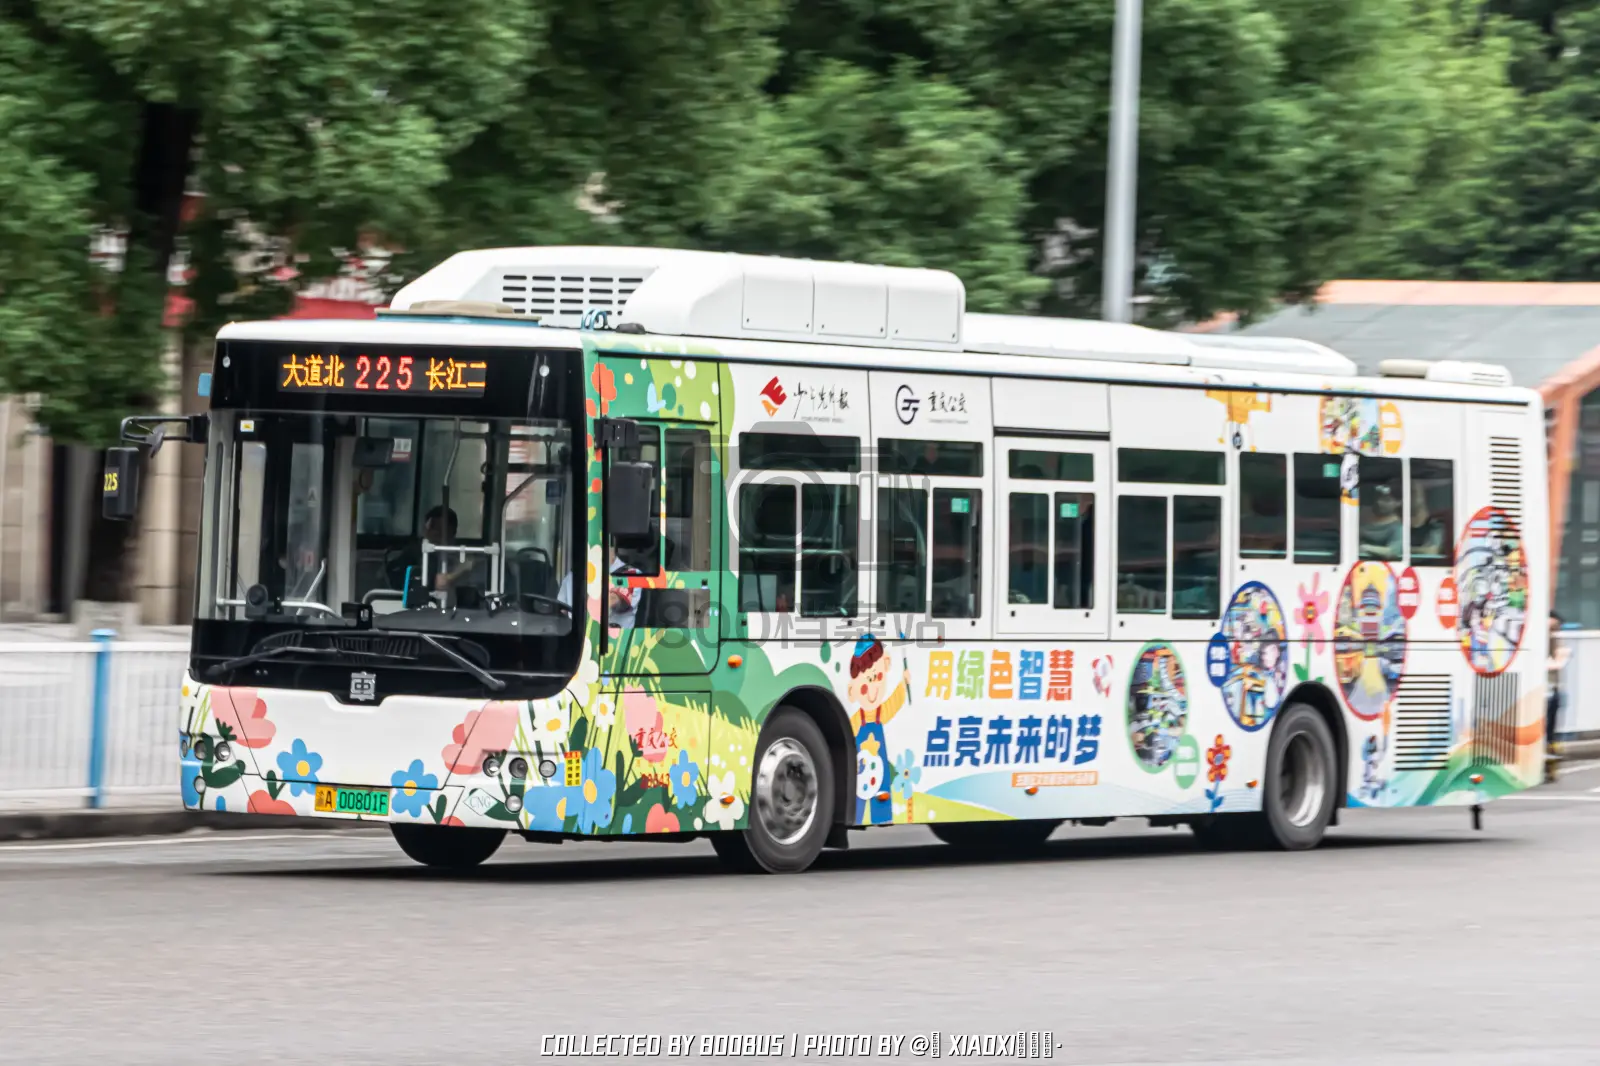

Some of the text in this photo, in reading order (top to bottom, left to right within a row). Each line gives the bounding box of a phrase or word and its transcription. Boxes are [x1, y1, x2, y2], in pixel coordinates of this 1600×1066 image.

[282, 354, 488, 392] 大道北 225 长江二
[104, 472, 118, 491] 225
[924, 648, 1074, 701] 用绿色智慧
[923, 714, 1103, 767] 点亮未来的梦
[470, 796, 490, 808] CNG
